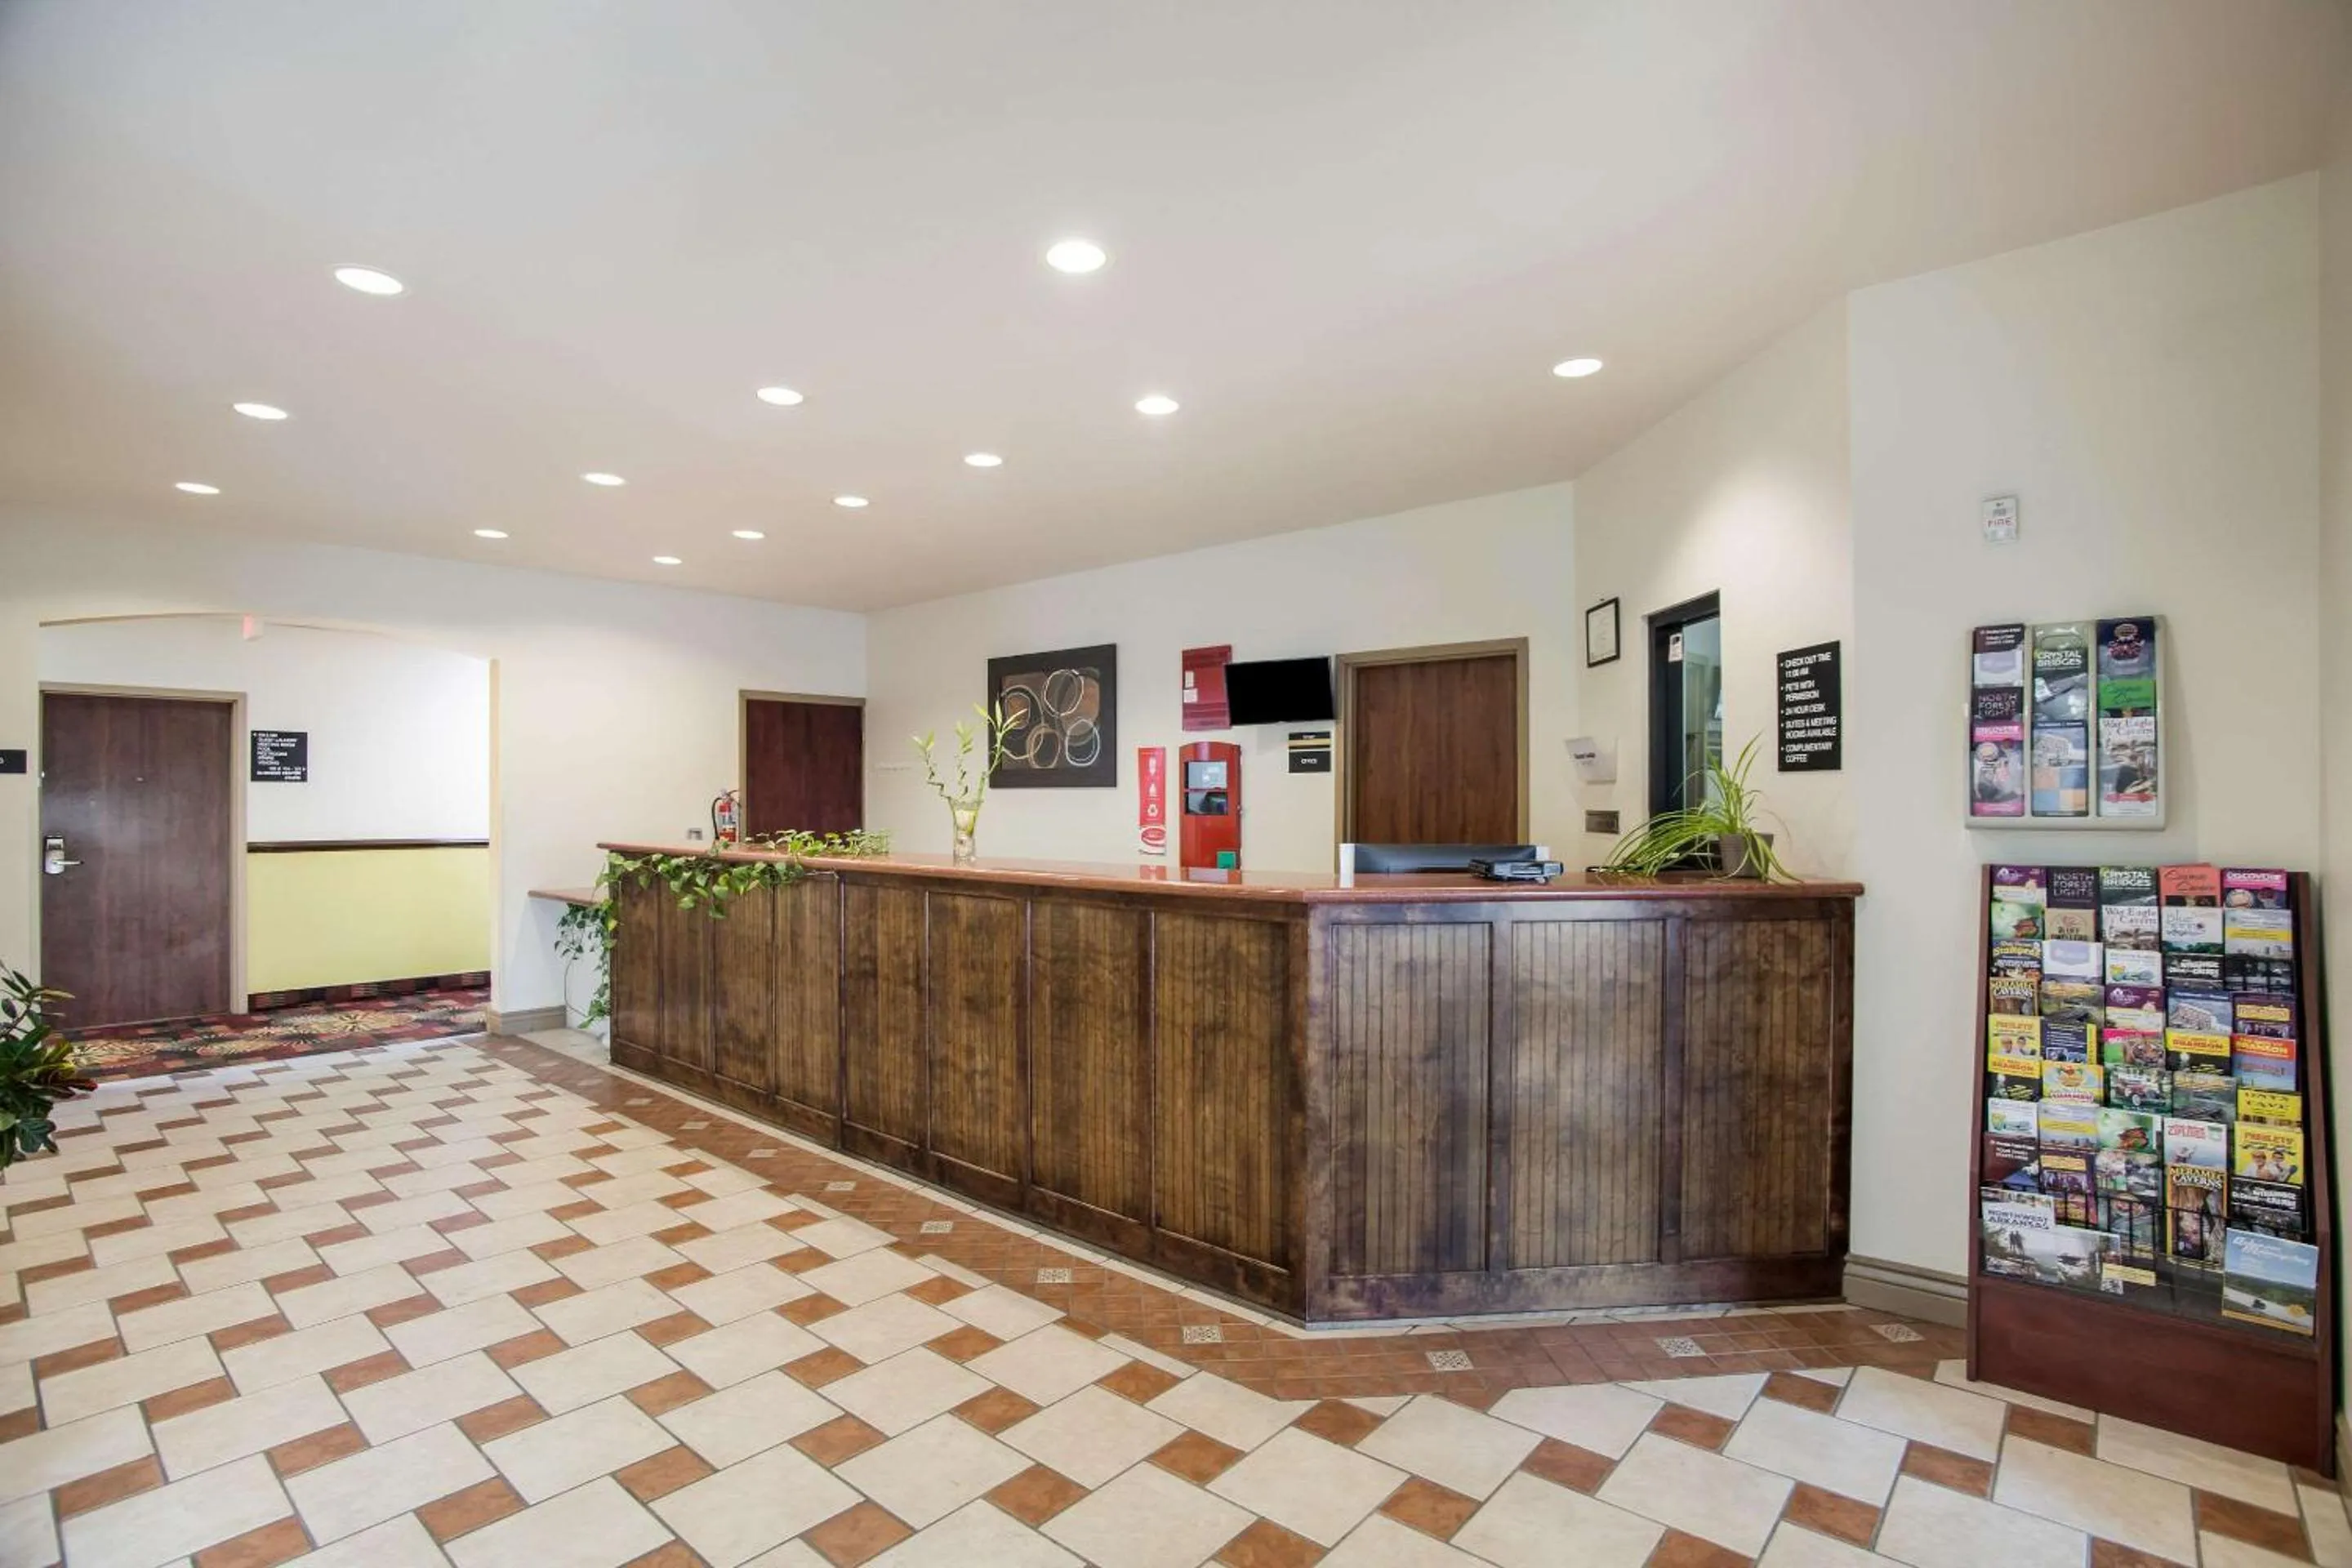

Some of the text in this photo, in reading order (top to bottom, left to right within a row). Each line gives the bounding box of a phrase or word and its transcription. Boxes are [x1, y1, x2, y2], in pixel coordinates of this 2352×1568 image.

[1785, 652, 1832, 668] CHECK OUT TIME
[2038, 650, 2082, 660] CRYSTAL
[2037, 658, 2082, 667] BRIDGES
[1785, 680, 1815, 692] PETS WITH
[1785, 690, 1820, 702] PERMISSION
[1978, 693, 2017, 702] NORTH
[1794, 706, 1808, 714] HOUR
[1809, 703, 1825, 713] DESK
[1978, 702, 2016, 710] FOREST
[1785, 719, 1805, 728] SUITES
[1811, 716, 1837, 727] MEETING
[1785, 727, 1837, 739] ROOMS AVAILABLE
[1786, 742, 1833, 753] COMPLIMENTARY
[1785, 754, 1808, 763] COFFEE
[2053, 872, 2094, 881] NORTH
[2104, 870, 2151, 879] CRYSTAL
[2053, 880, 2093, 889] FOREST
[2104, 878, 2152, 887] BRIDGES
[2053, 889, 2093, 898] LIGHTS
[1993, 988, 2033, 997] CAVERNS
[2170, 1167, 2225, 1182] MERAMEC
[2172, 1175, 2222, 1190] CAVERNS
[1988, 1209, 2048, 1223] NORTHWEST
[1988, 1216, 2050, 1230] ARKANSAS
